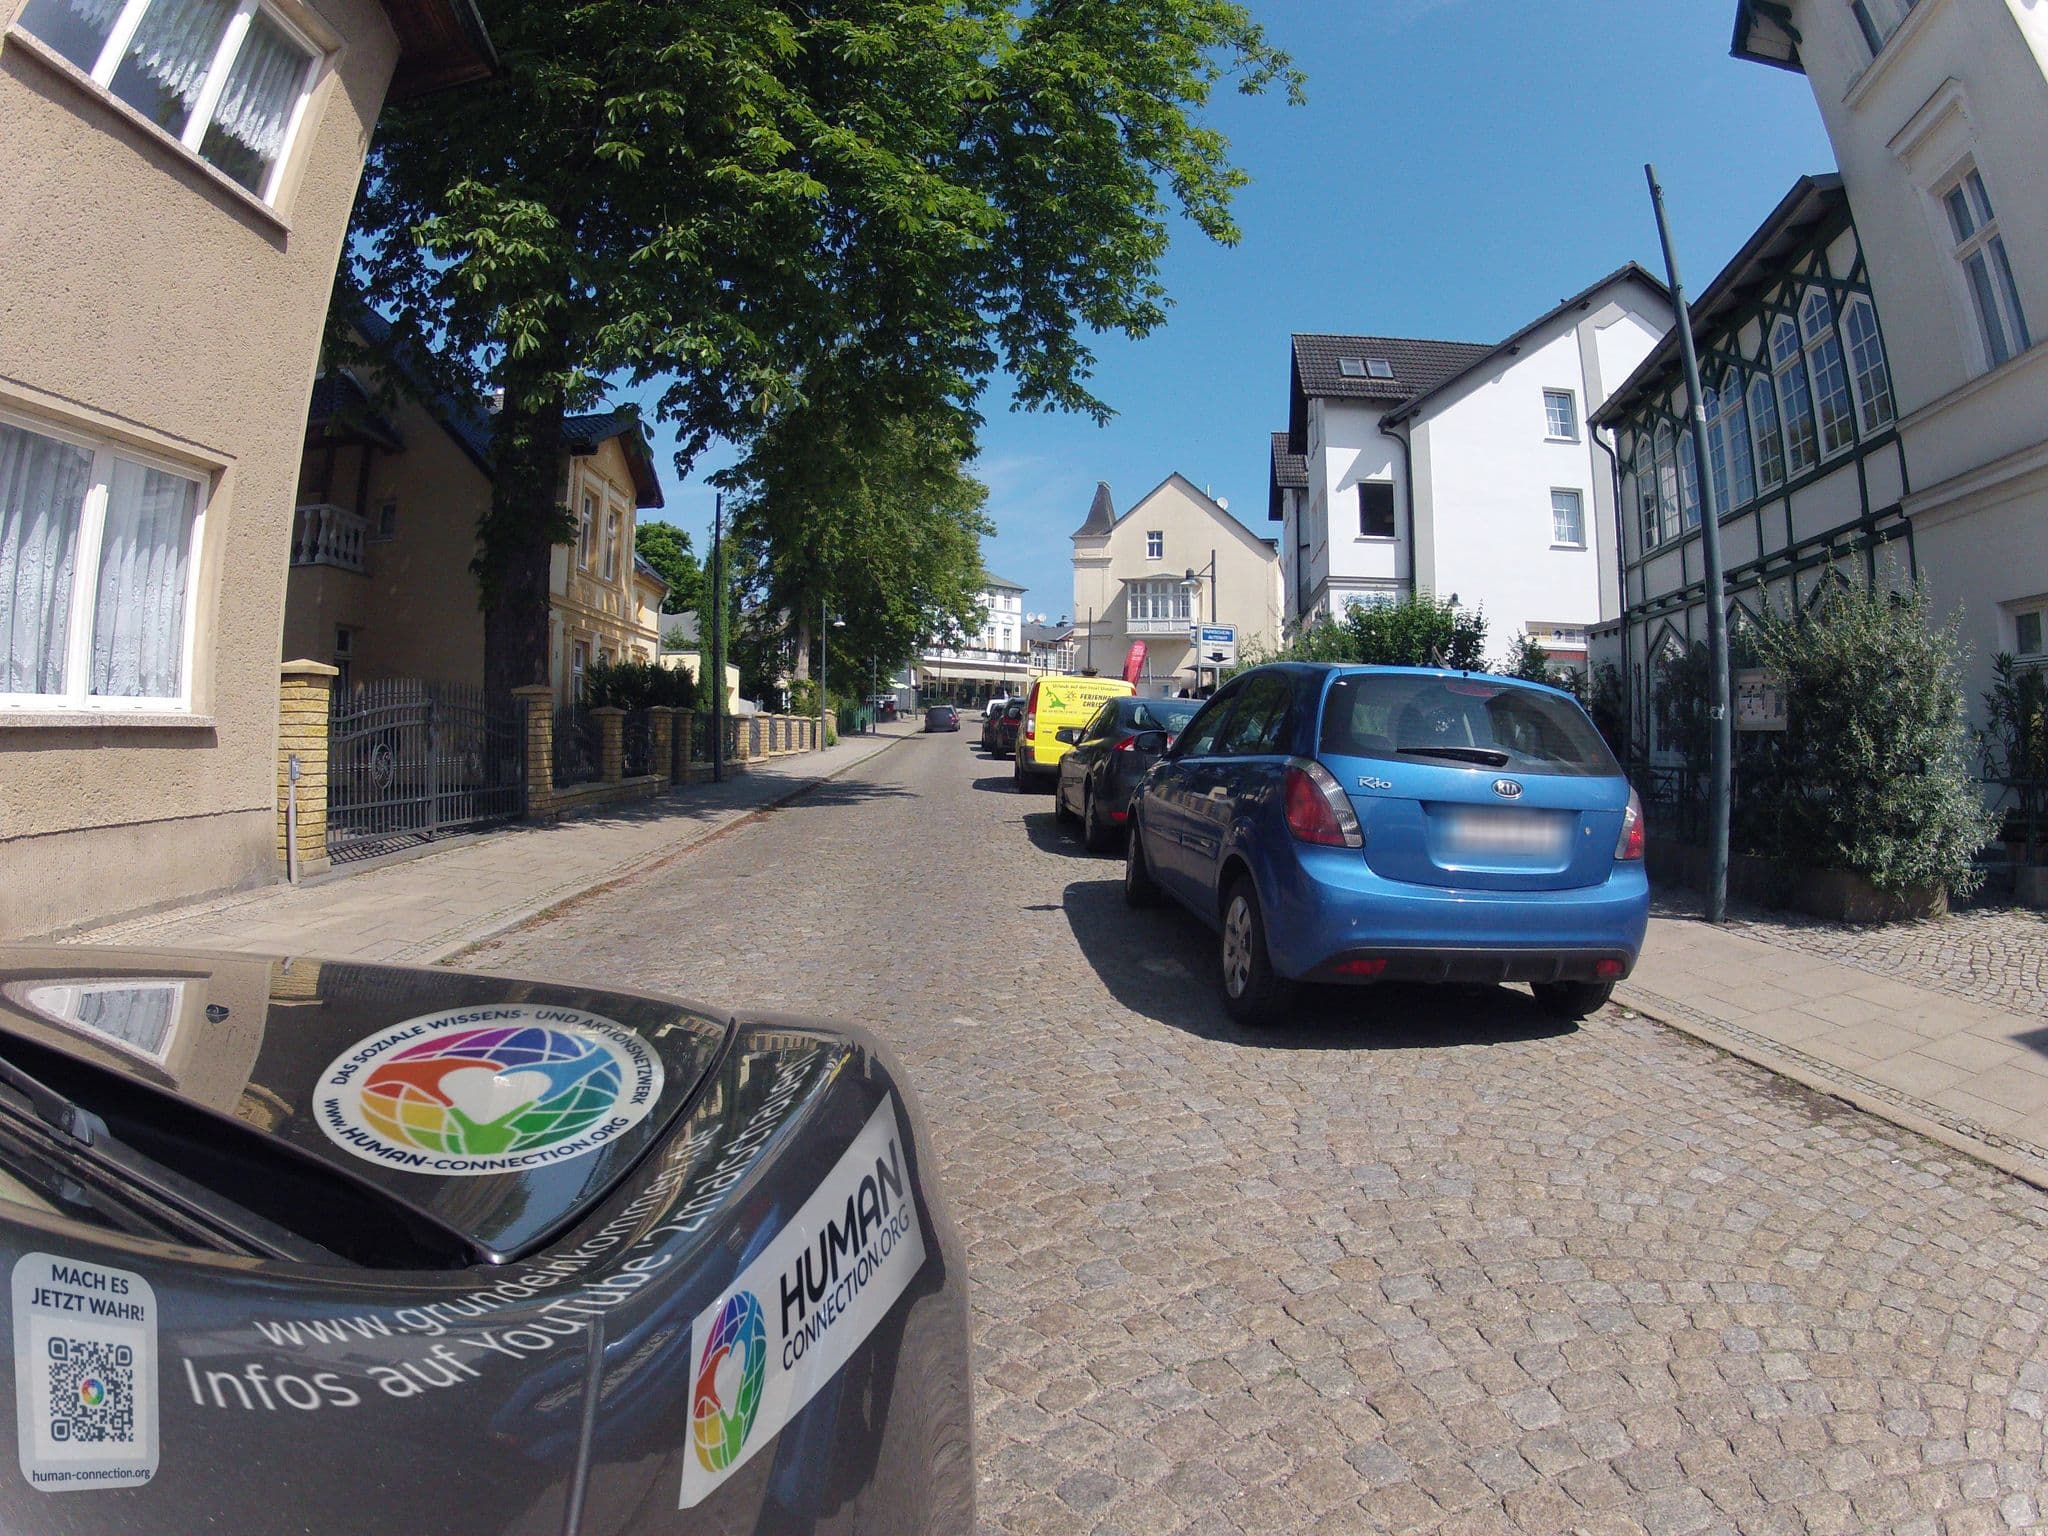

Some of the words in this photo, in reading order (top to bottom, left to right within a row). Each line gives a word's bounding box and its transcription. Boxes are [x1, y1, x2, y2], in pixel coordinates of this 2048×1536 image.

[1358, 776, 1392, 789] Rio
[1496, 781, 1519, 795] KIA
[330, 1062, 358, 1086] DAS
[359, 1025, 424, 1066] SOZIALE
[426, 1009, 529, 1031] WISSENS-
[536, 1010, 580, 1025] UND
[578, 1018, 653, 1105] AKTIONSNETZWERK
[779, 1138, 905, 1339] HUMAN
[52, 1264, 106, 1291] MACH
[111, 1277, 129, 1295] ES
[782, 1203, 910, 1371] CONNECTION.ORG
[32, 1287, 85, 1312] JETZT
[89, 1298, 145, 1322] WAHR!
[182, 1357, 360, 1411] Infos
[367, 1344, 482, 1399] auf
[459, 1253, 673, 1360] YouTube
[32, 1467, 151, 1483] human-connection.org
